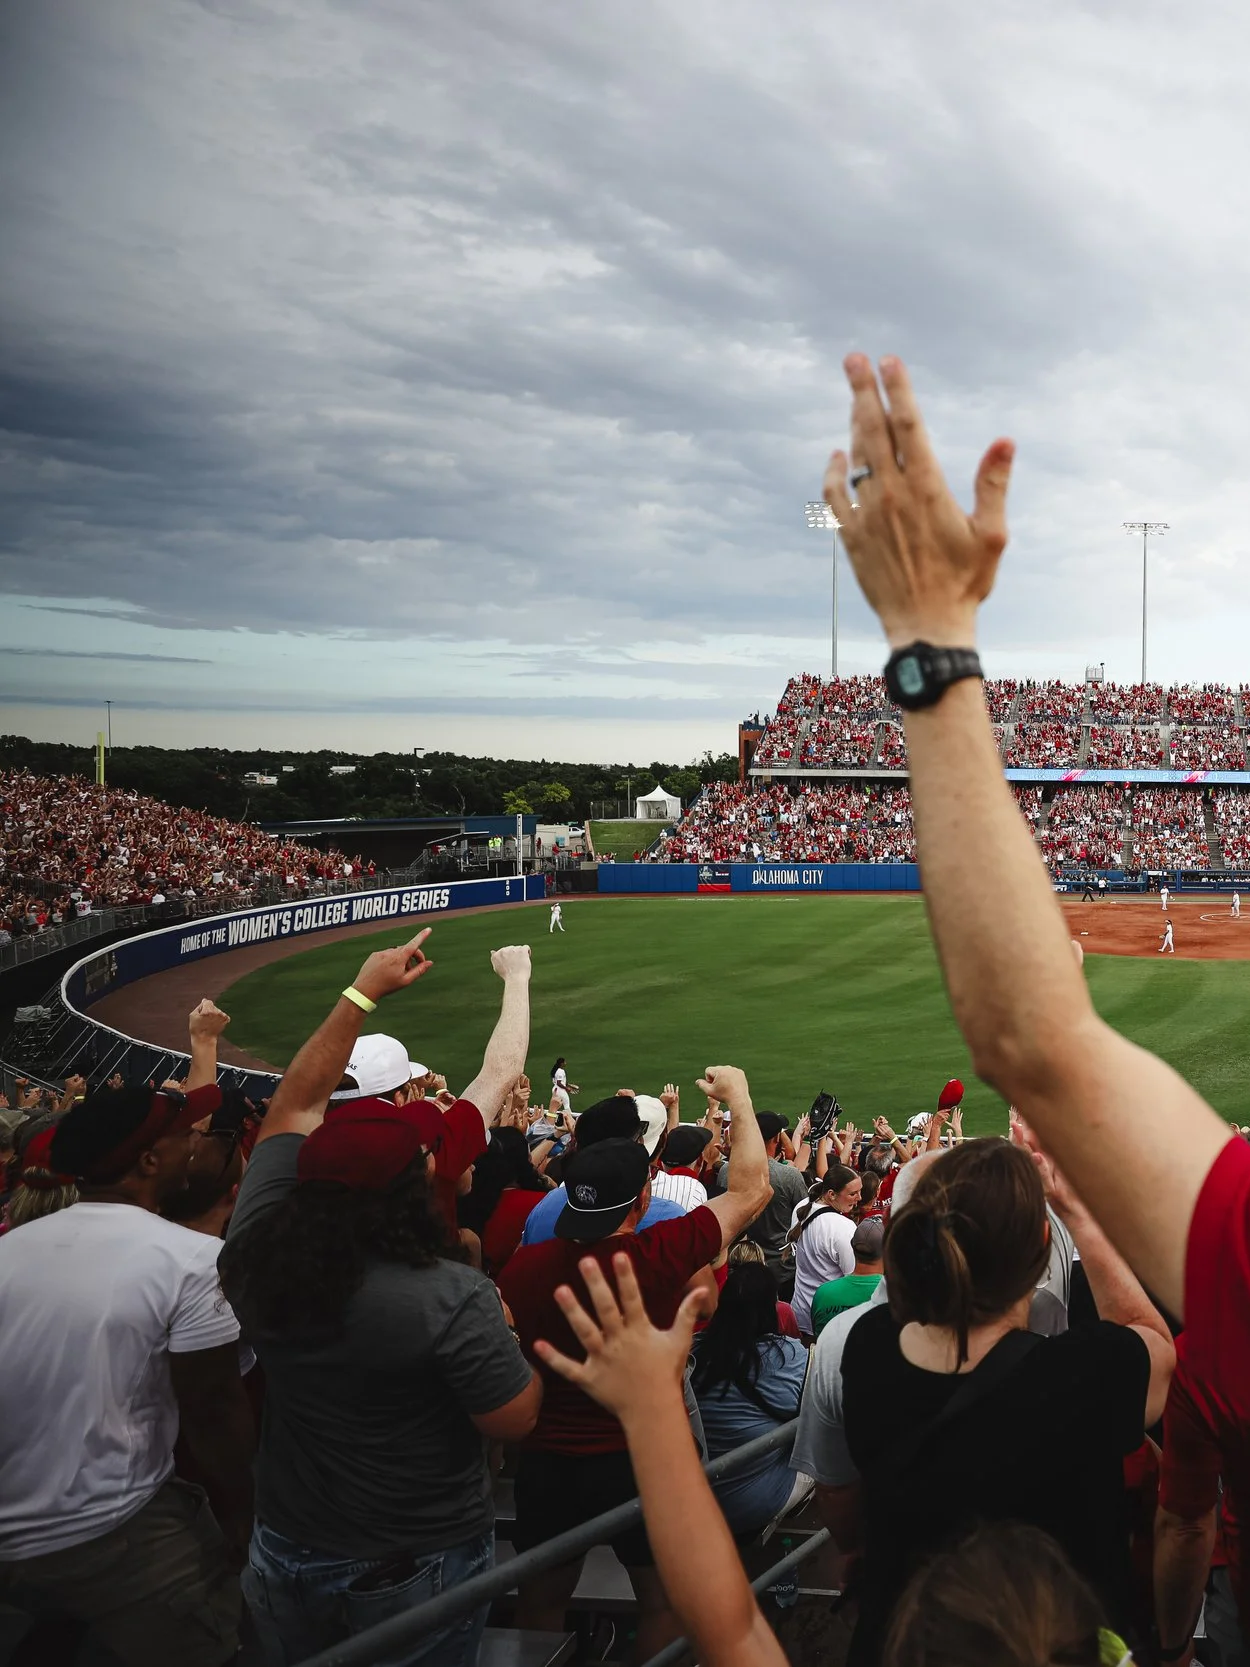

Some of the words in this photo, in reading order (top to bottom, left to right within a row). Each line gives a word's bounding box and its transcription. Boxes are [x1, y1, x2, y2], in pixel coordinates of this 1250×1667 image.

[752, 868, 800, 885] OKLAHOMA
[803, 869, 824, 885] CITY
[180, 932, 201, 954] HOME
[201, 930, 212, 948] OF
[211, 927, 226, 944] THE
[228, 911, 291, 946] WOMEN'S
[293, 901, 350, 931] COLLEGE
[352, 894, 399, 922] WORLD
[400, 889, 450, 914] SERIES
